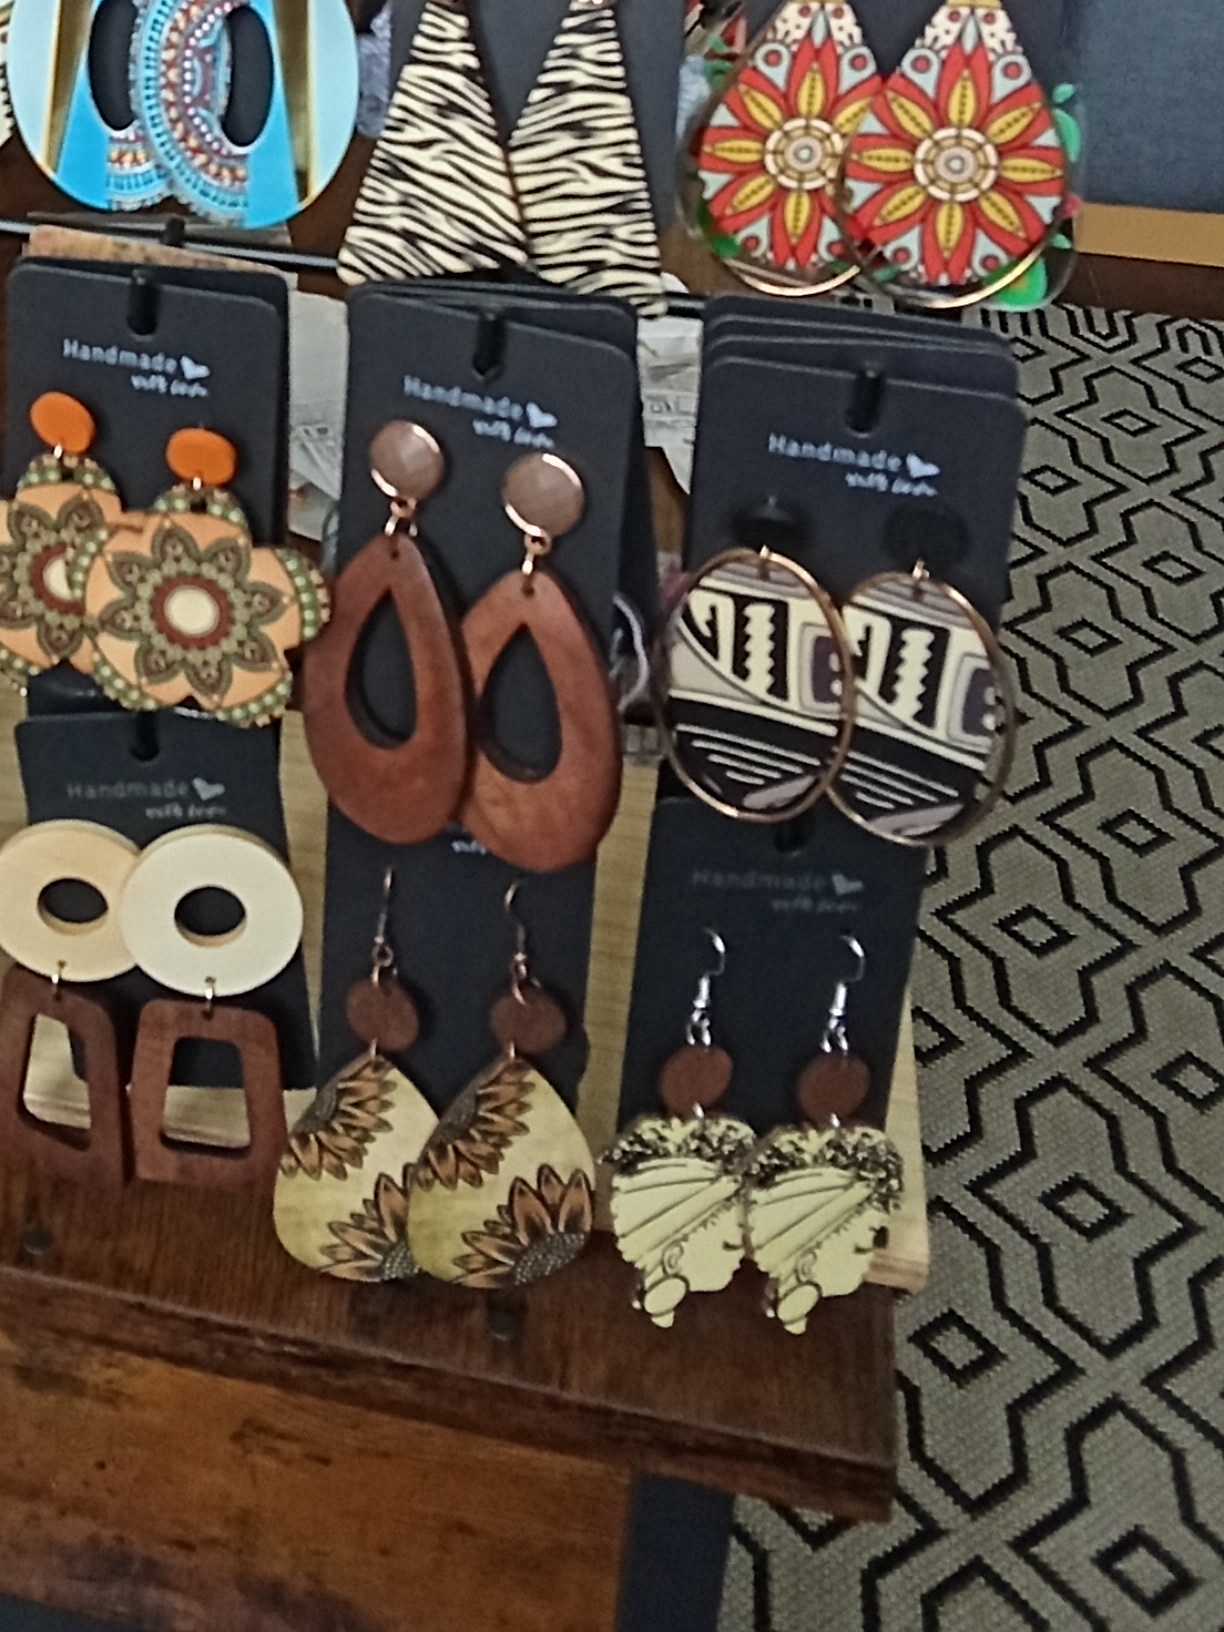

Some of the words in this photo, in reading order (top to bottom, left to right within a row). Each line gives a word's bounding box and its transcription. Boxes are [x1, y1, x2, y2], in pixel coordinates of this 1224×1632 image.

[63, 338, 177, 374] Handmade
[404, 375, 523, 420] Handmade
[769, 432, 901, 472] Handmade
[67, 780, 188, 799] Handmade
[692, 871, 827, 889] Handmade
